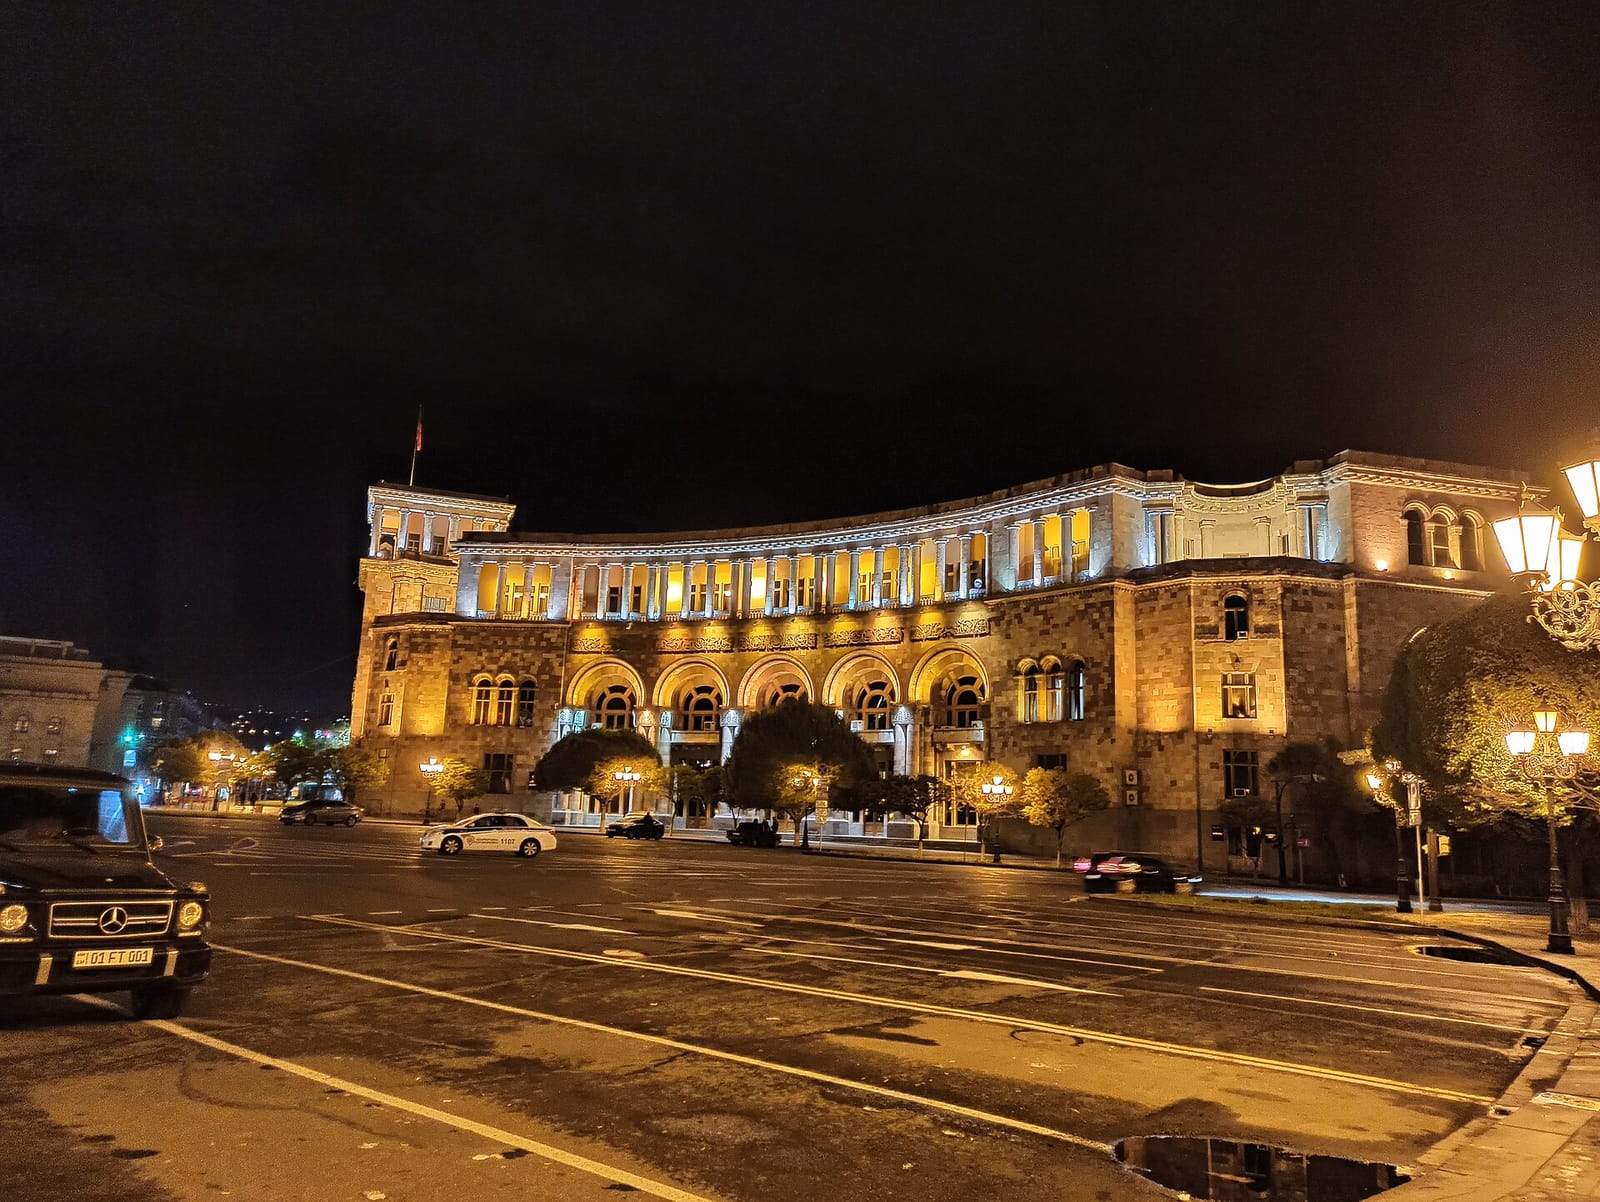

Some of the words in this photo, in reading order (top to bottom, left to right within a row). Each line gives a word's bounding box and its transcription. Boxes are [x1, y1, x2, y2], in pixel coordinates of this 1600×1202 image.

[90, 952, 105, 965] 01
[108, 951, 126, 964] FT
[128, 950, 149, 963] 001
